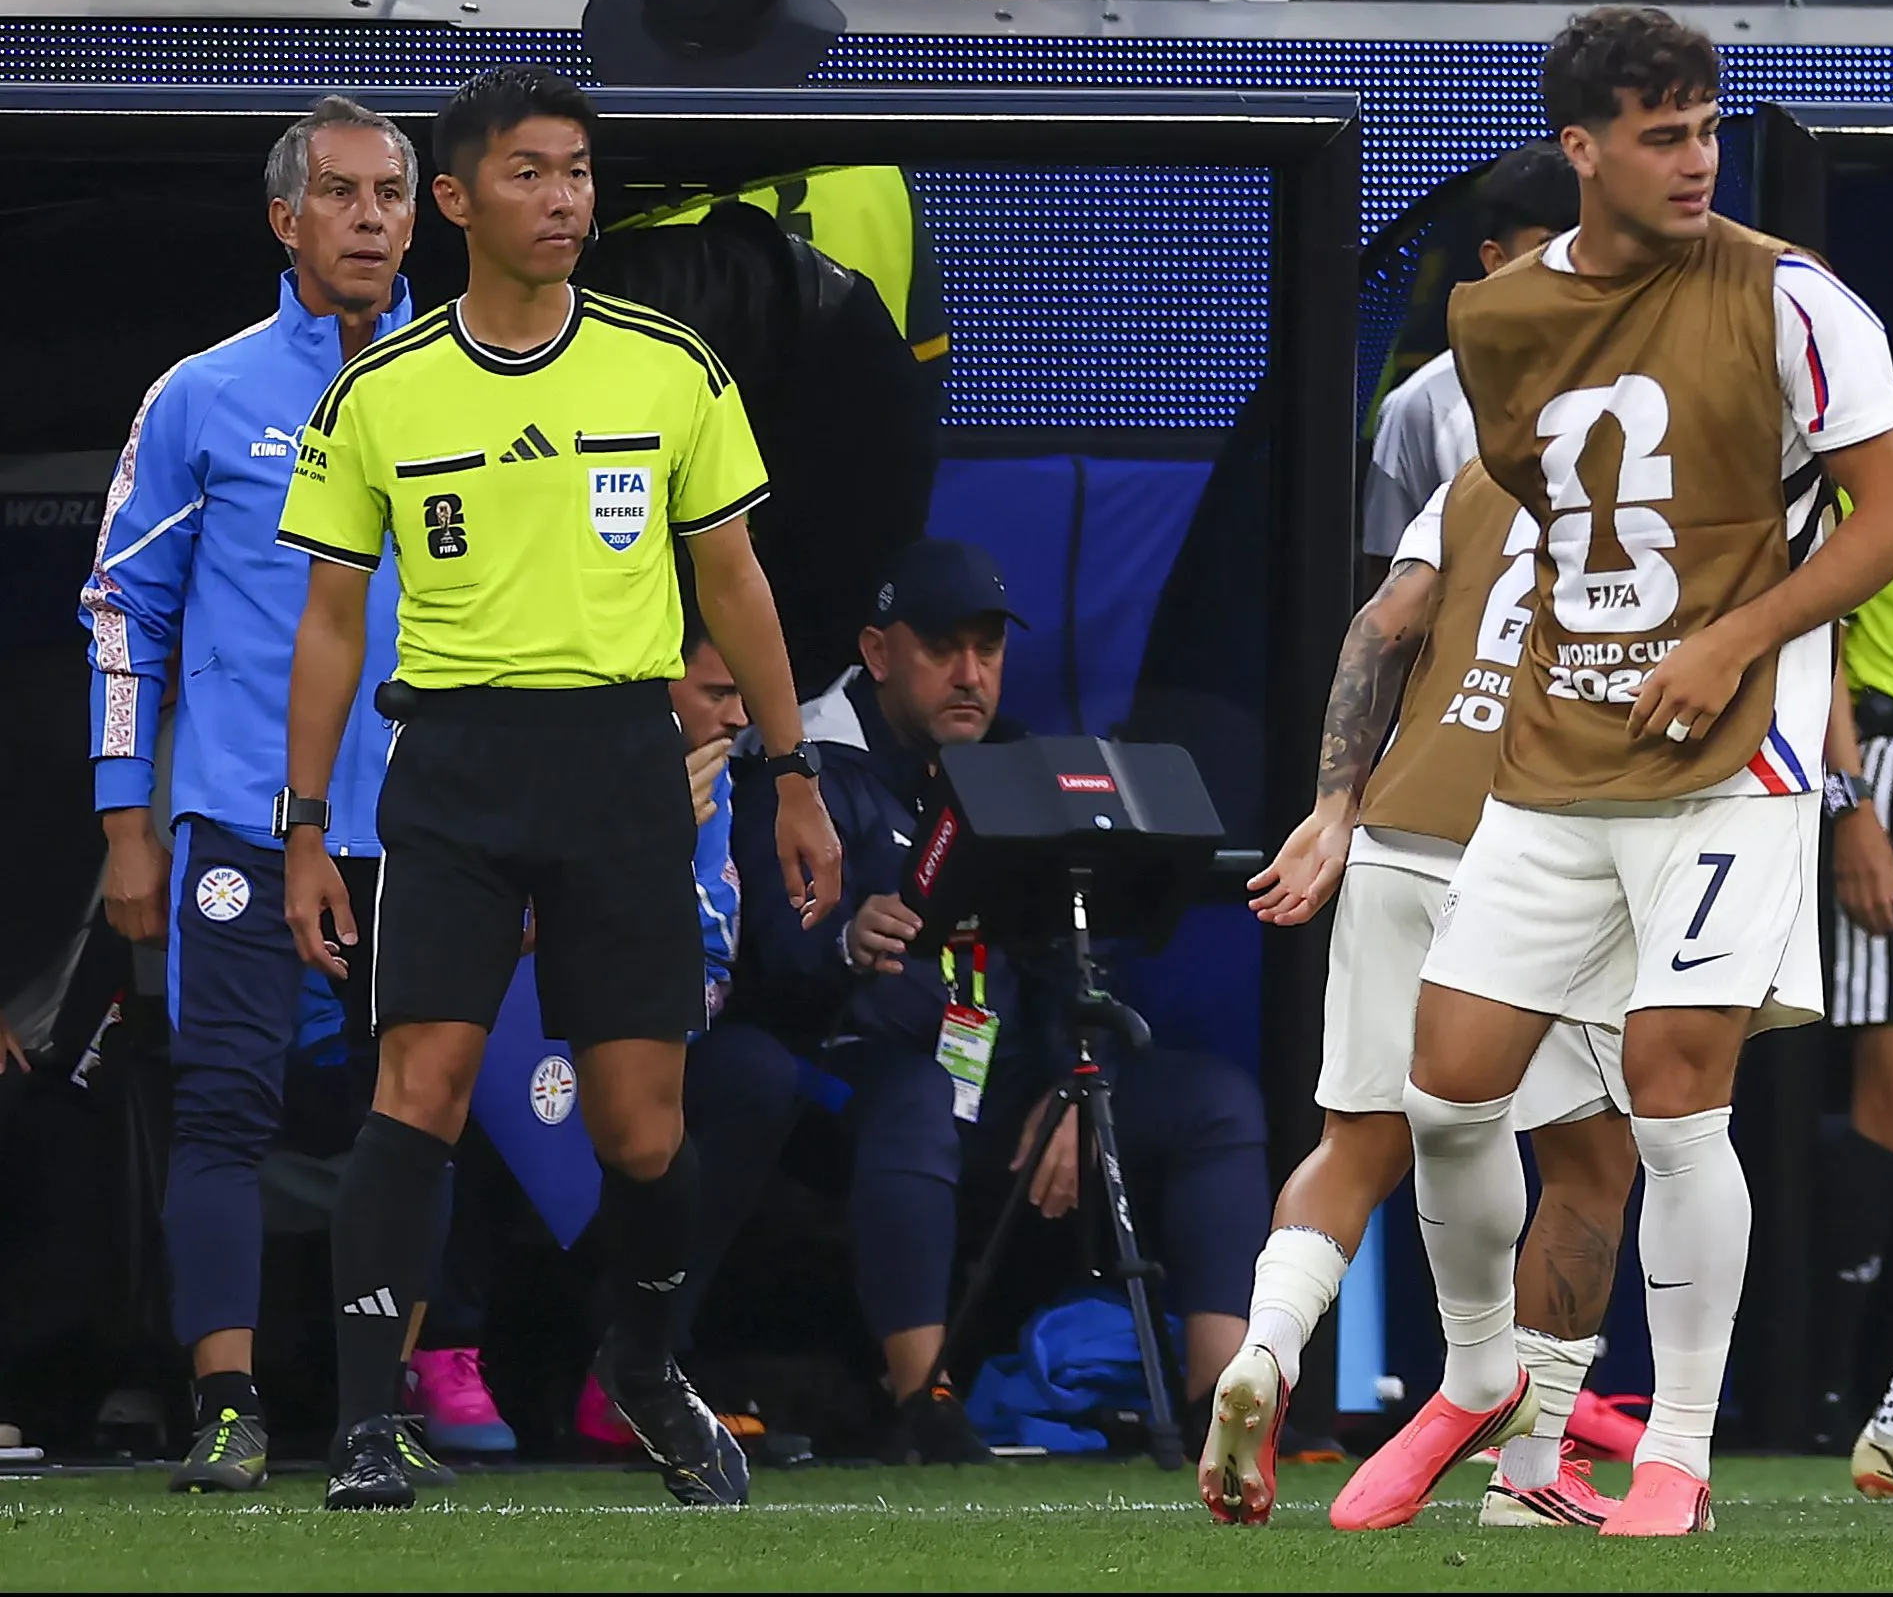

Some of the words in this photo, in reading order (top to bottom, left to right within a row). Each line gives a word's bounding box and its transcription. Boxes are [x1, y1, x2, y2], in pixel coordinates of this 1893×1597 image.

[250, 442, 287, 458] KING
[299, 443, 327, 470] IFA
[595, 473, 646, 494] FIFA
[5, 499, 101, 526] WORL
[595, 506, 645, 519] REFEREE
[439, 544, 459, 555] FIFA
[608, 533, 632, 545] 2026
[1586, 581, 1641, 610] FIFA
[1556, 643, 1625, 667] WORLD
[1546, 665, 1656, 704] 202
[1060, 775, 1110, 789] Lenovo
[918, 820, 954, 887] Lenovo
[214, 871, 232, 881] APF
[1683, 852, 1737, 940] 7
